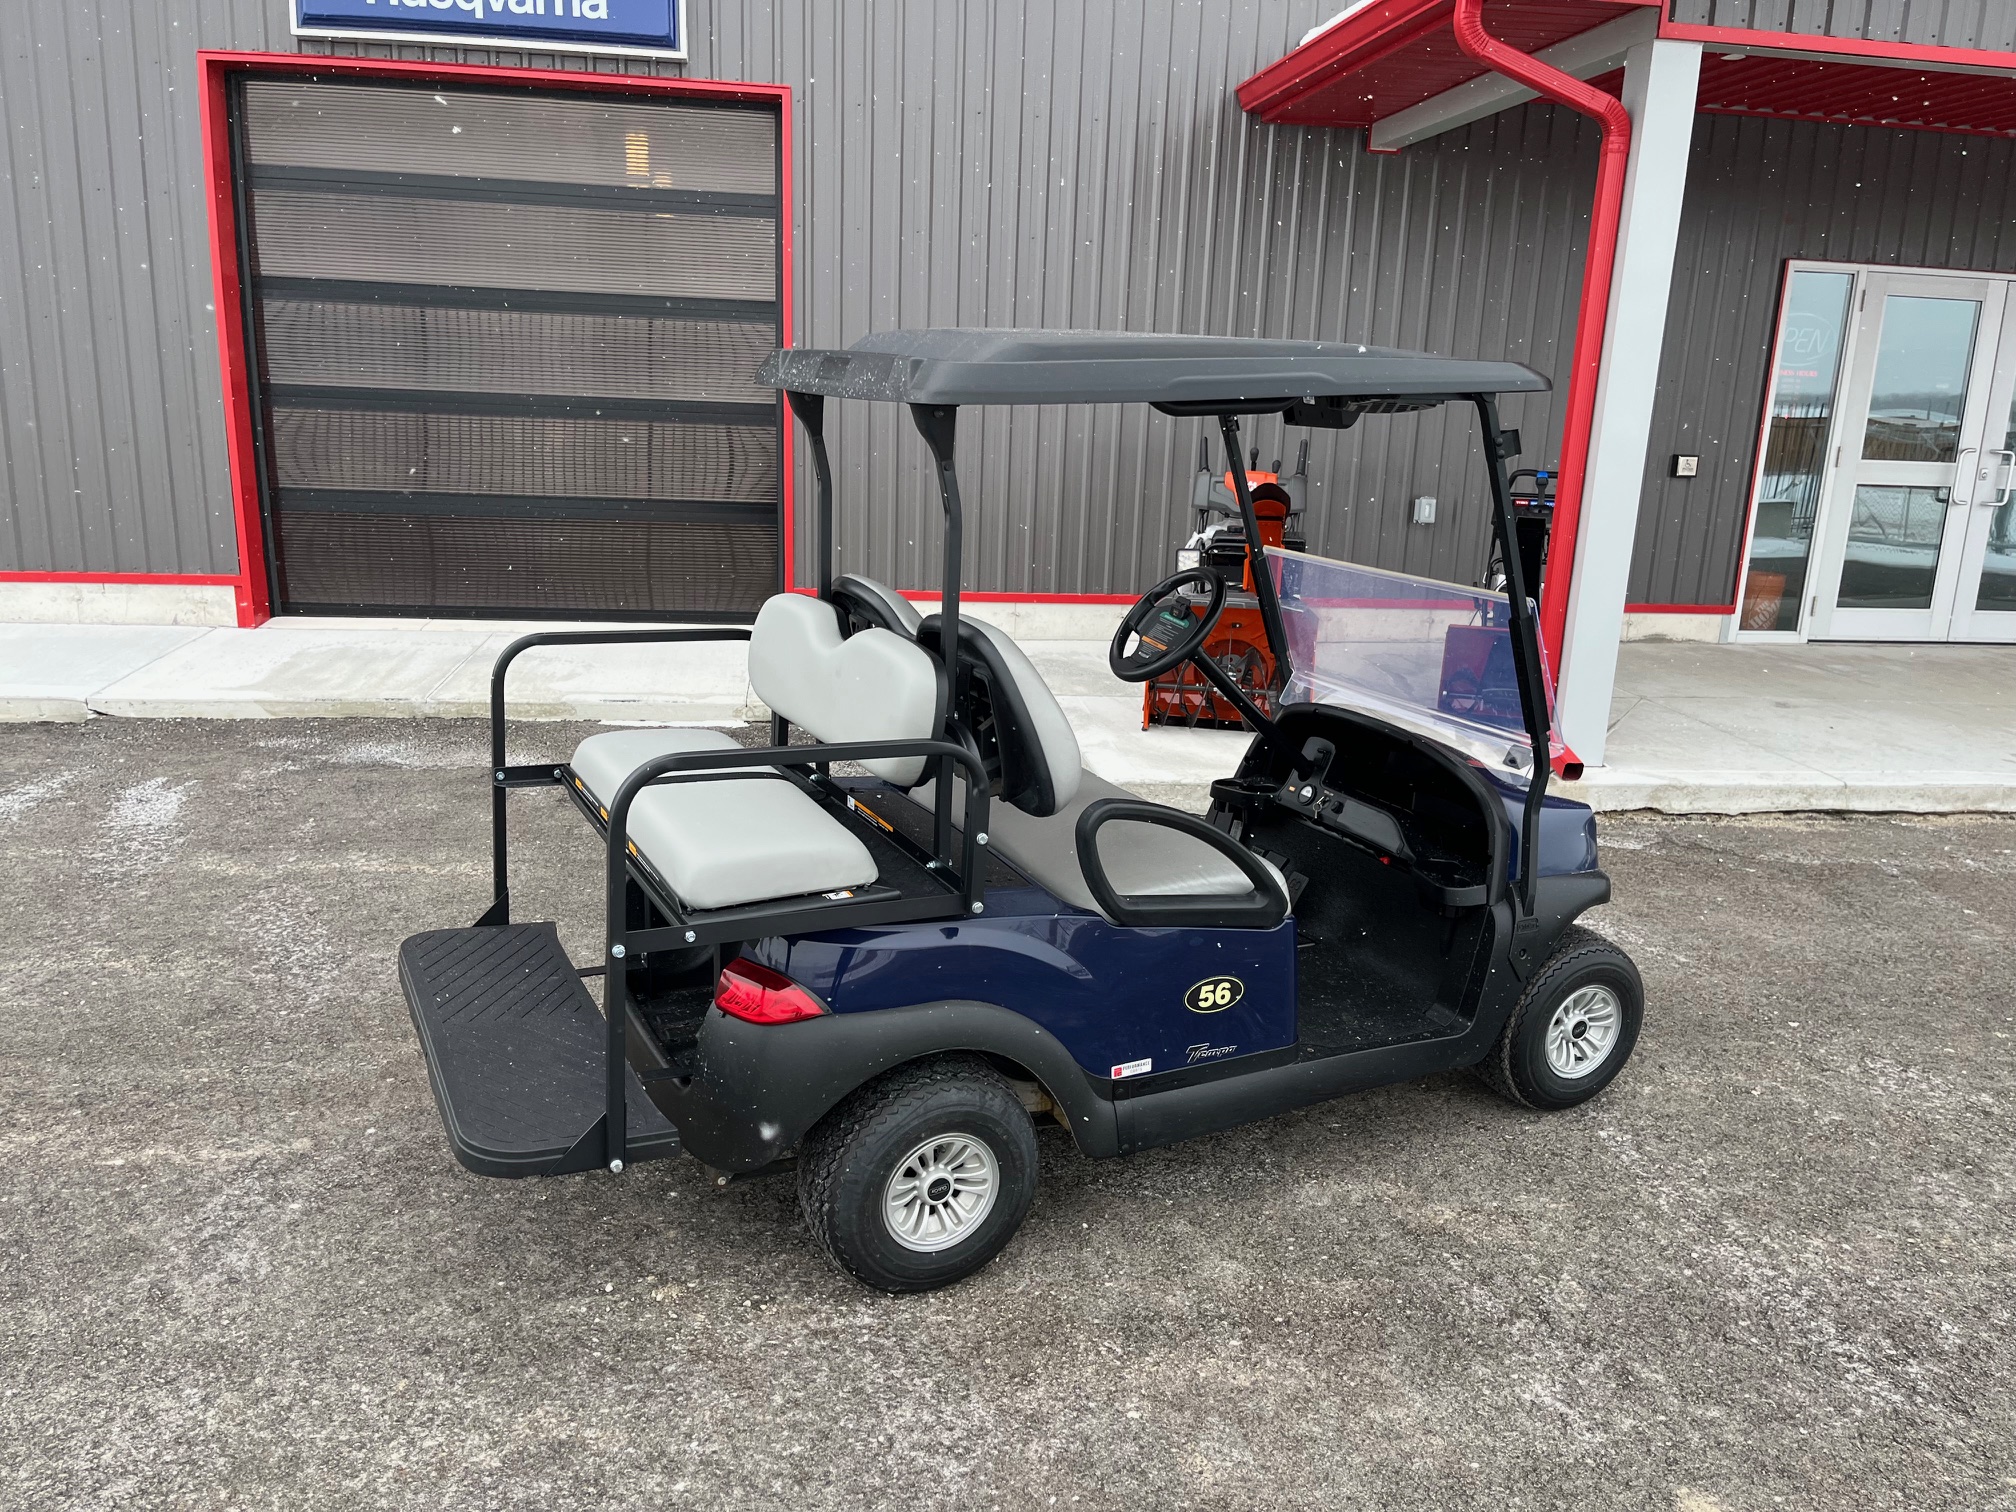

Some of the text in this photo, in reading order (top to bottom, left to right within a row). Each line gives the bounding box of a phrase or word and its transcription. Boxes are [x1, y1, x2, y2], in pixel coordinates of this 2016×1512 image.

[366, 0, 608, 19] qarna
[1784, 327, 1830, 353] PEN
[1197, 982, 1231, 1008] 56
[1186, 1043, 1238, 1063] Tempo
